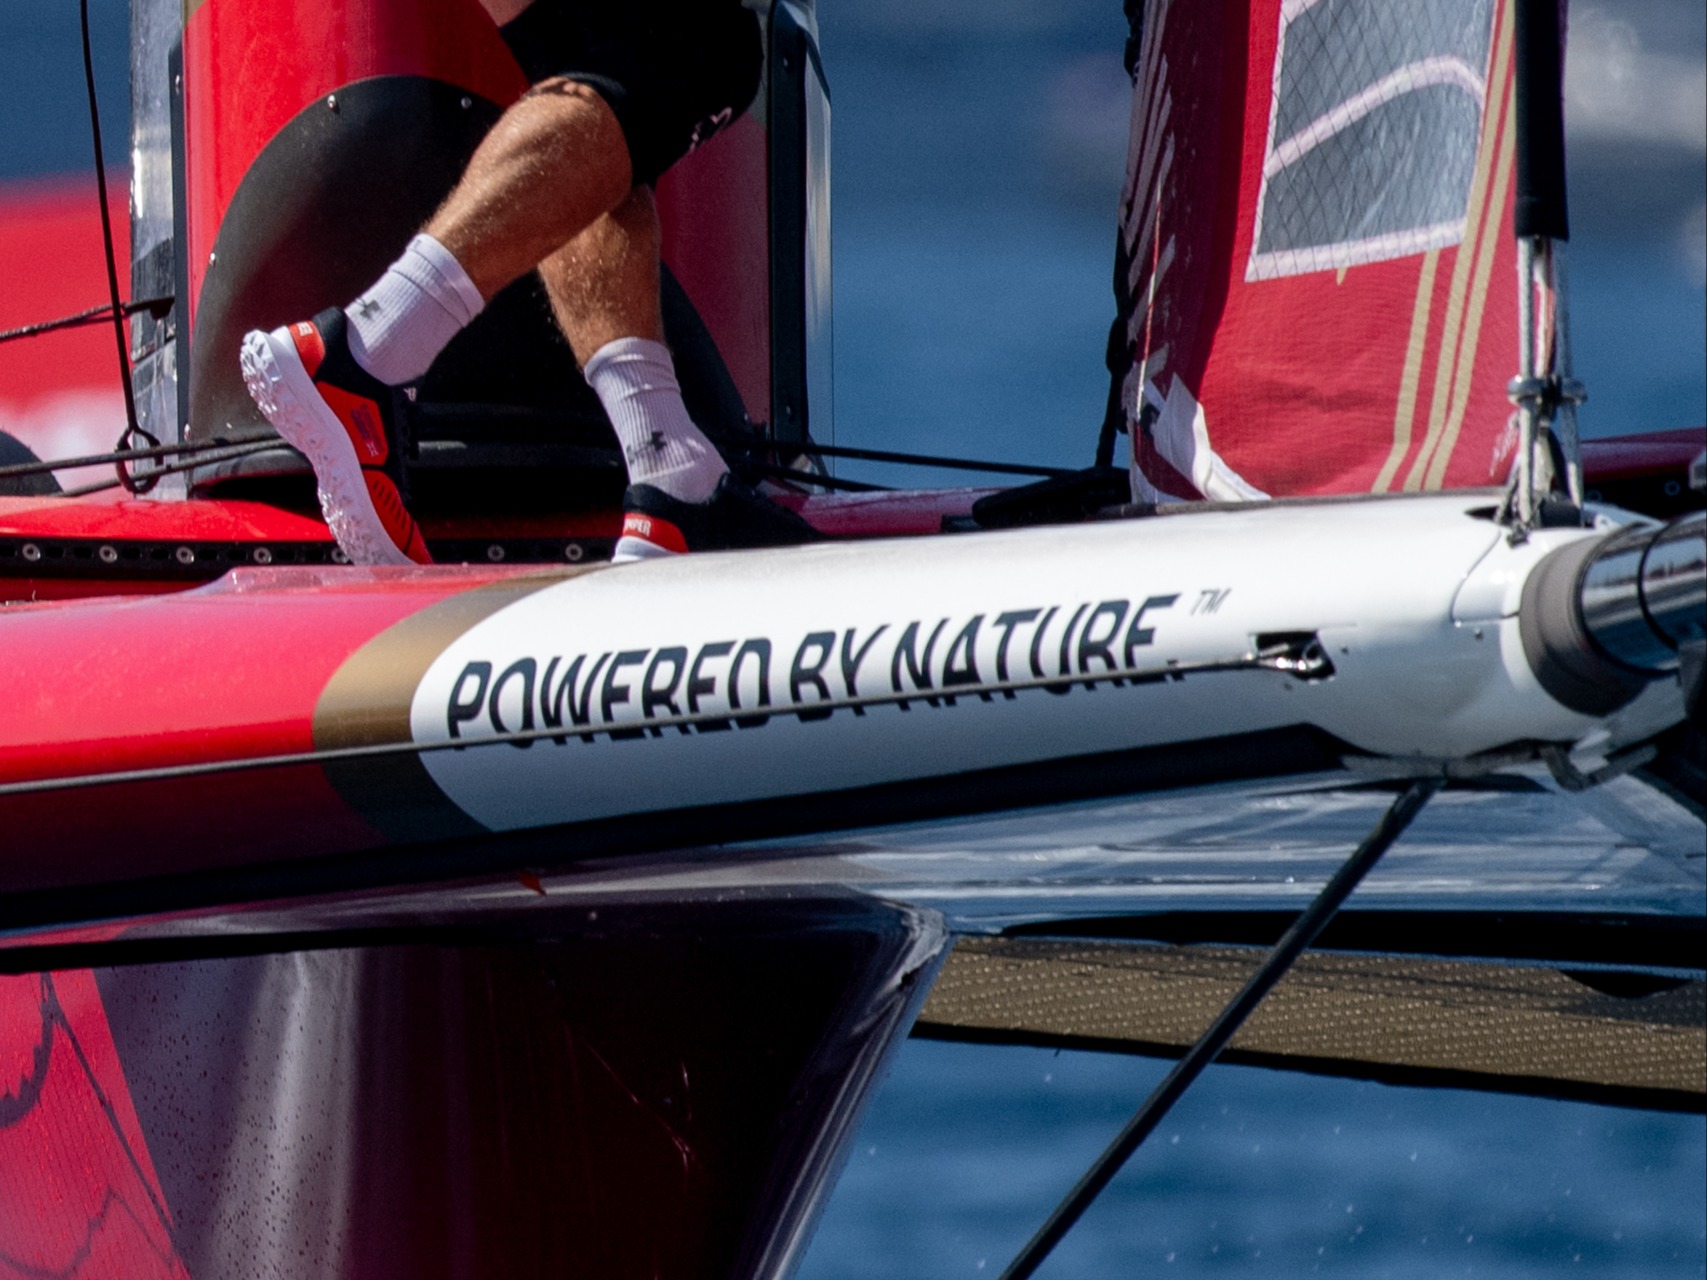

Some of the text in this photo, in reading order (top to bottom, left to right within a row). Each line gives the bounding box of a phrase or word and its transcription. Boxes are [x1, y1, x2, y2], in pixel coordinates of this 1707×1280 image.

[446, 637, 773, 752] POWERED
[791, 623, 890, 723] BY
[891, 592, 1184, 713] NATURE
